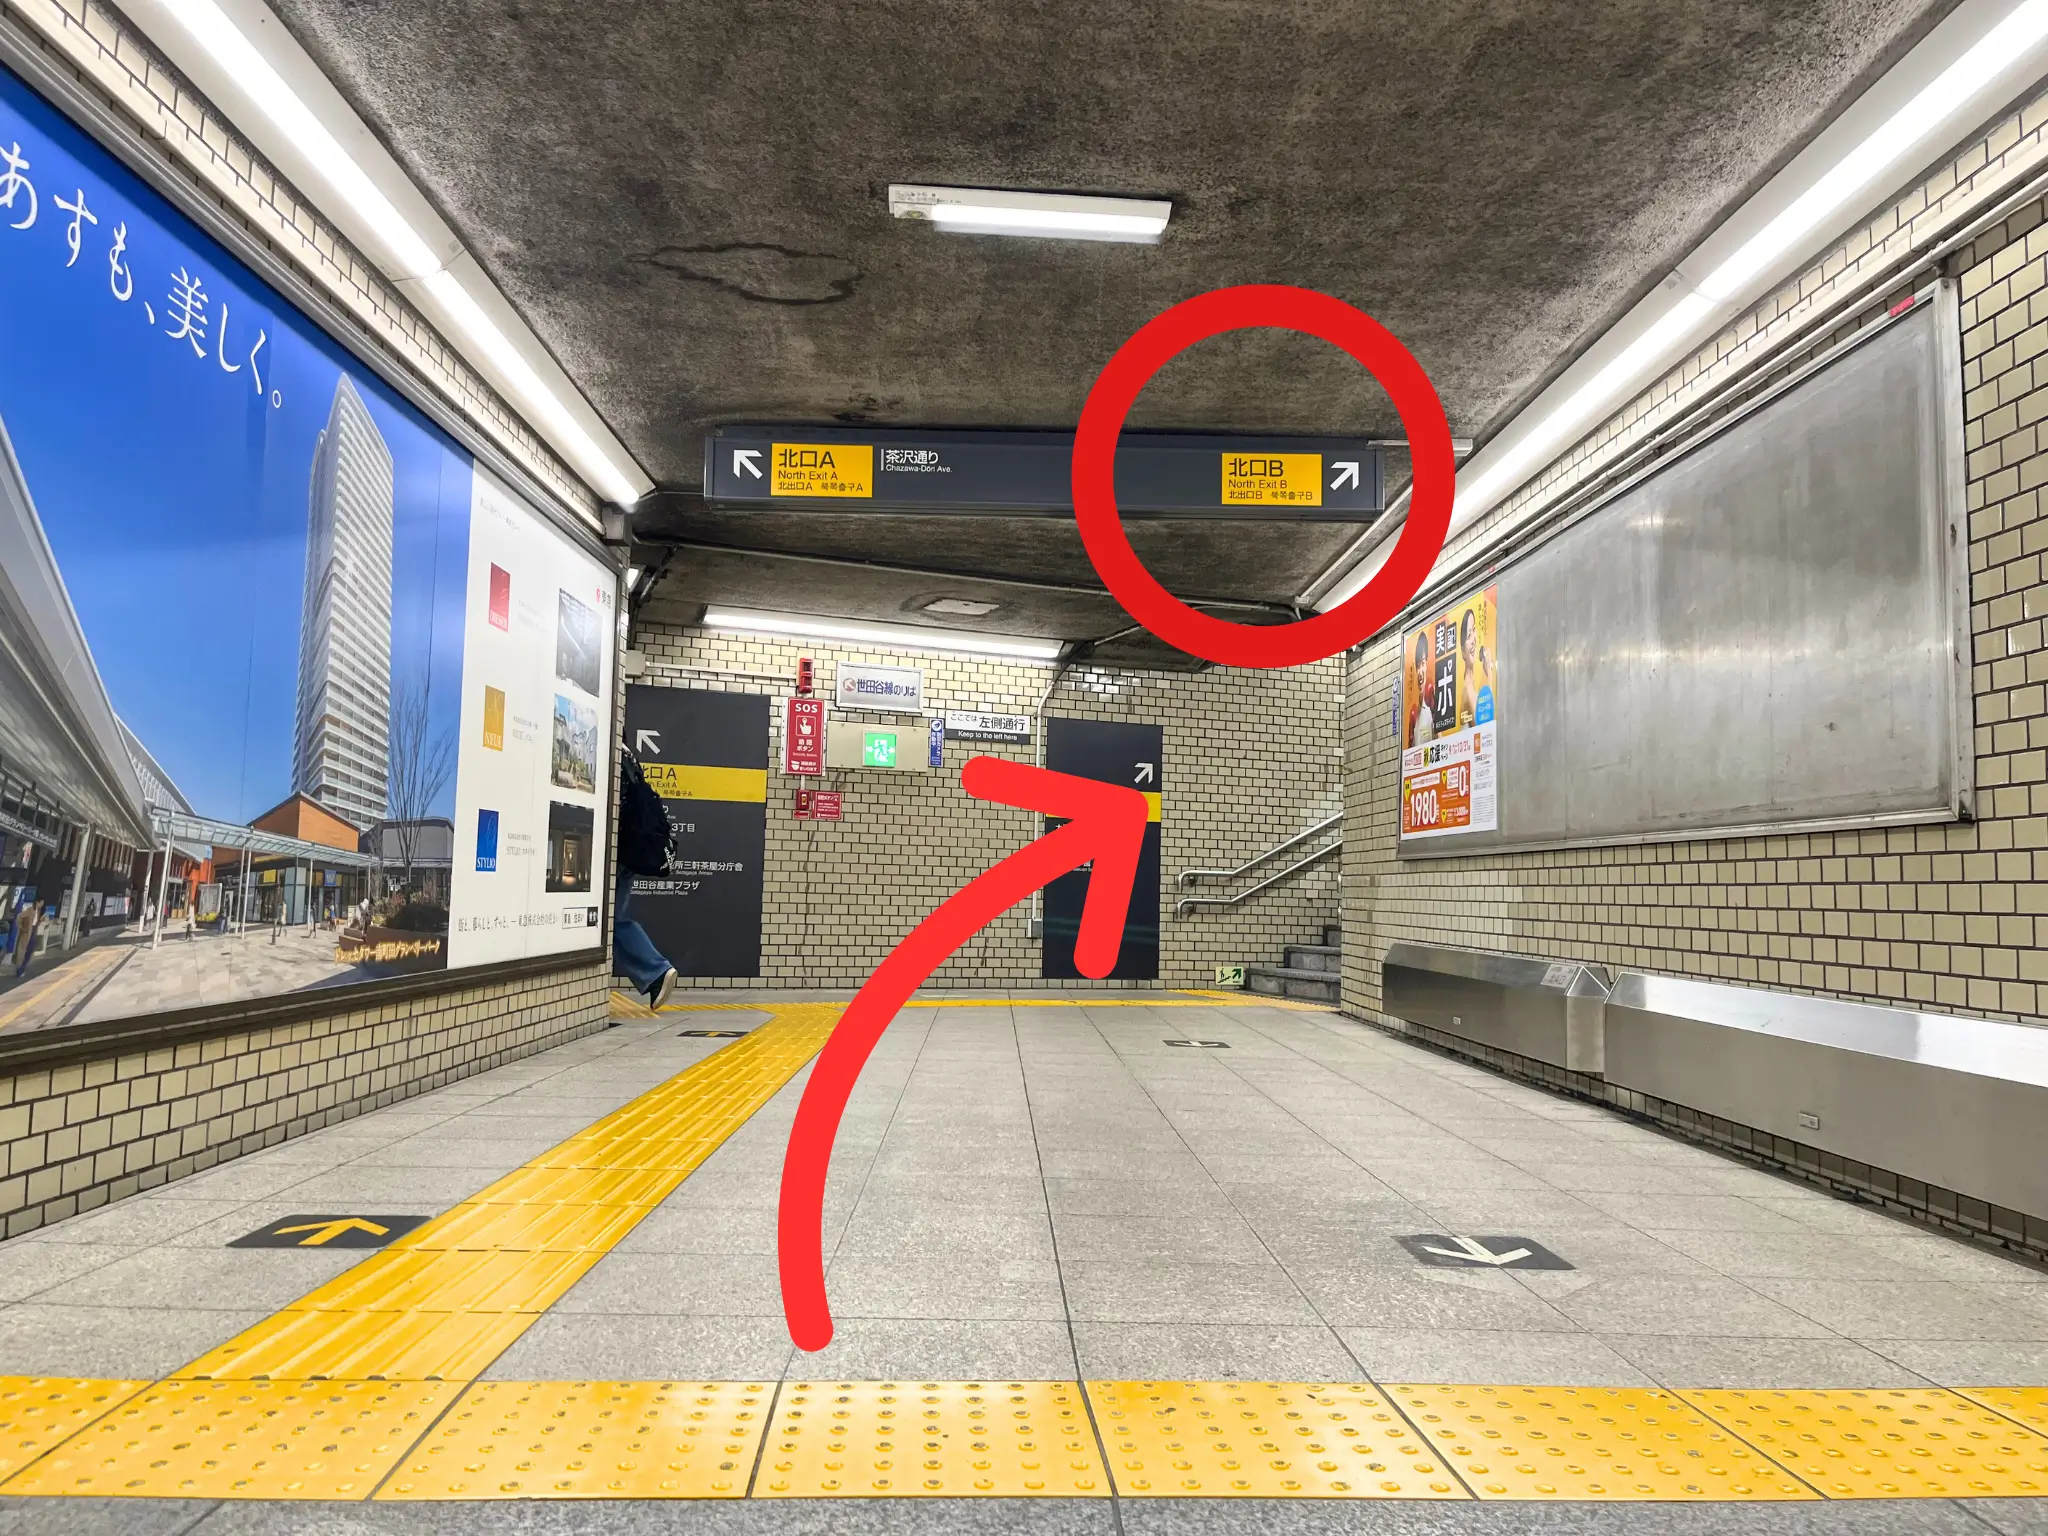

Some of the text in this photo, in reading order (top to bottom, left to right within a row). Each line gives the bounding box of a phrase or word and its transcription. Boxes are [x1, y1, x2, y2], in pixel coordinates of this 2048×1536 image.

[0, 141, 283, 409] あすも、美しく。
[778, 448, 836, 469] 北口A
[885, 449, 939, 465] 茶沢通り
[937, 465, 953, 473] Ave.
[1228, 457, 1284, 477] 北口B
[778, 470, 838, 481] North Exit A
[778, 481, 813, 491] 北出口A
[1228, 479, 1288, 489] North Exit B
[1228, 490, 1263, 500] 北出口B
[856, 677, 917, 697] 世田谷線のりば
[795, 703, 818, 713] SOS
[950, 713, 1026, 731] ここでは 左側通行
[958, 731, 974, 739] Keep
[993, 732, 1003, 740] left
[1003, 733, 1018, 741] here
[477, 856, 496, 869] STYLIO
